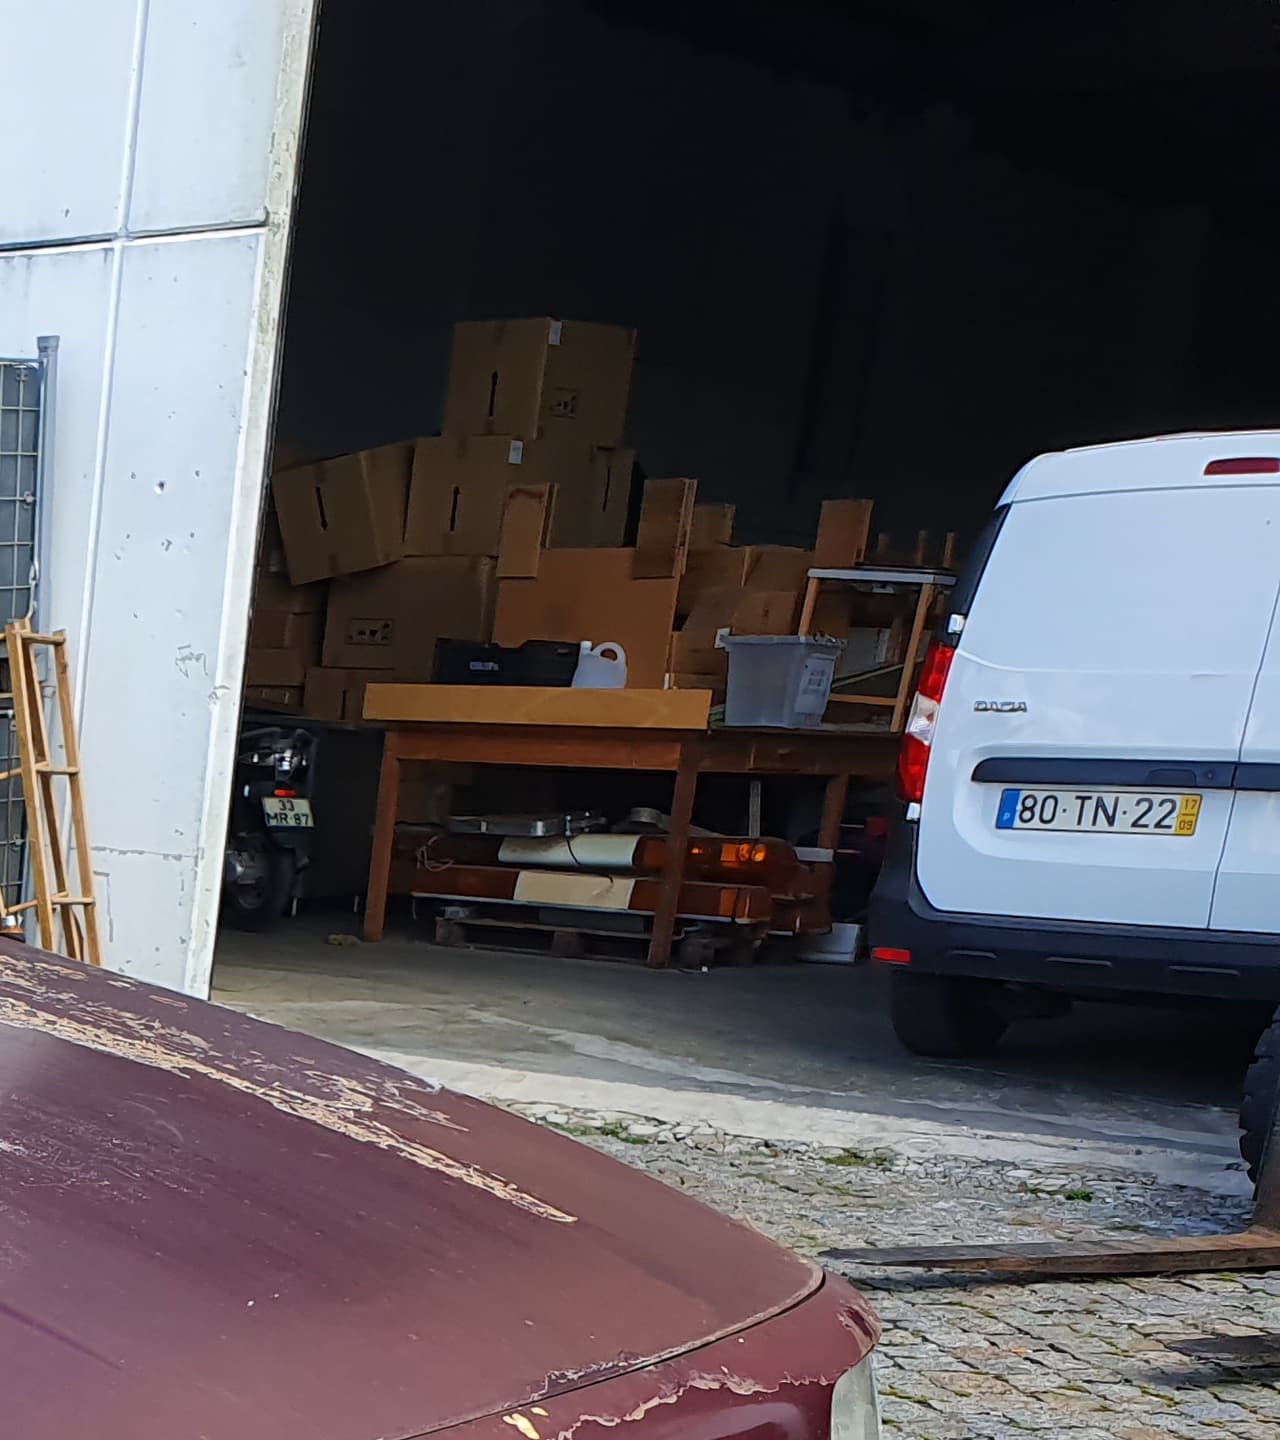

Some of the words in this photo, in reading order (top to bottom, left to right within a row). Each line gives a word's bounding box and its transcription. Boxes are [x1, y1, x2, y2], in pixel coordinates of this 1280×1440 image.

[973, 700, 1028, 713] DACIA
[1183, 799, 1197, 811] 17
[1002, 812, 1011, 821] P
